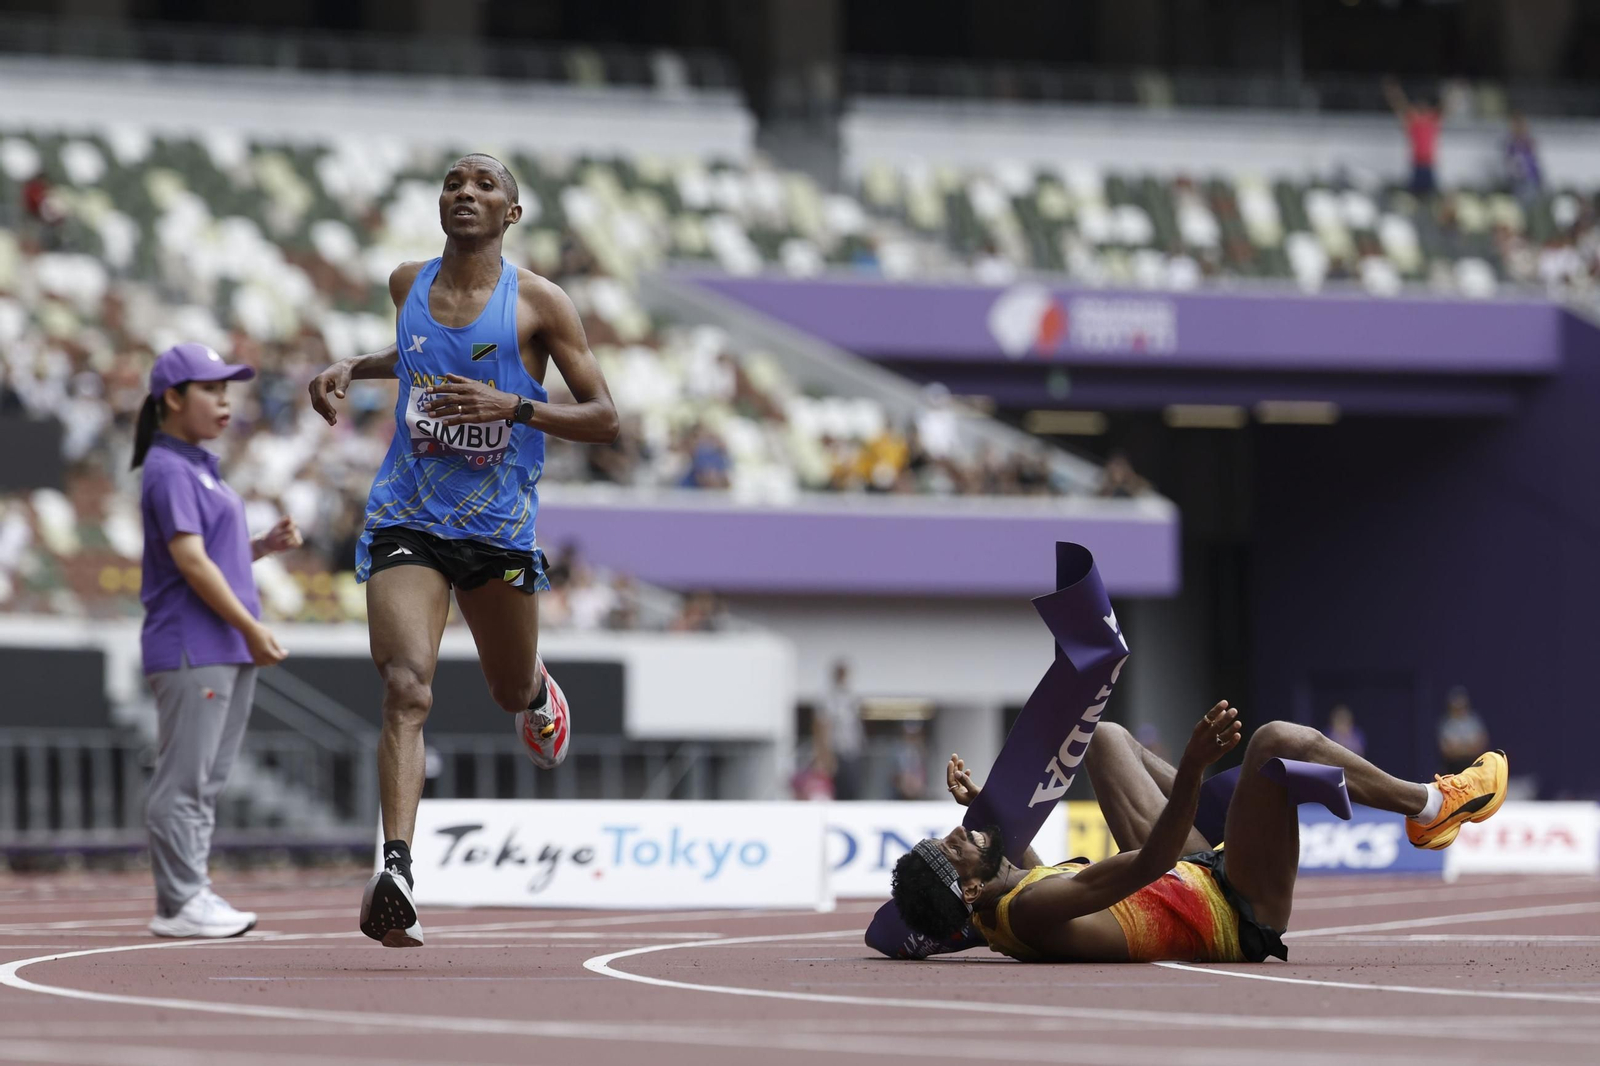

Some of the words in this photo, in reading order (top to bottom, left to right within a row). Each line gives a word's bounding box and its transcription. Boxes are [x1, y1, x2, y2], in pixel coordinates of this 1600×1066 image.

[409, 370, 497, 389] ANZA
[416, 420, 503, 449] SIMBU
[435, 824, 595, 893] Tokyo
[602, 827, 769, 880] Tokyo
